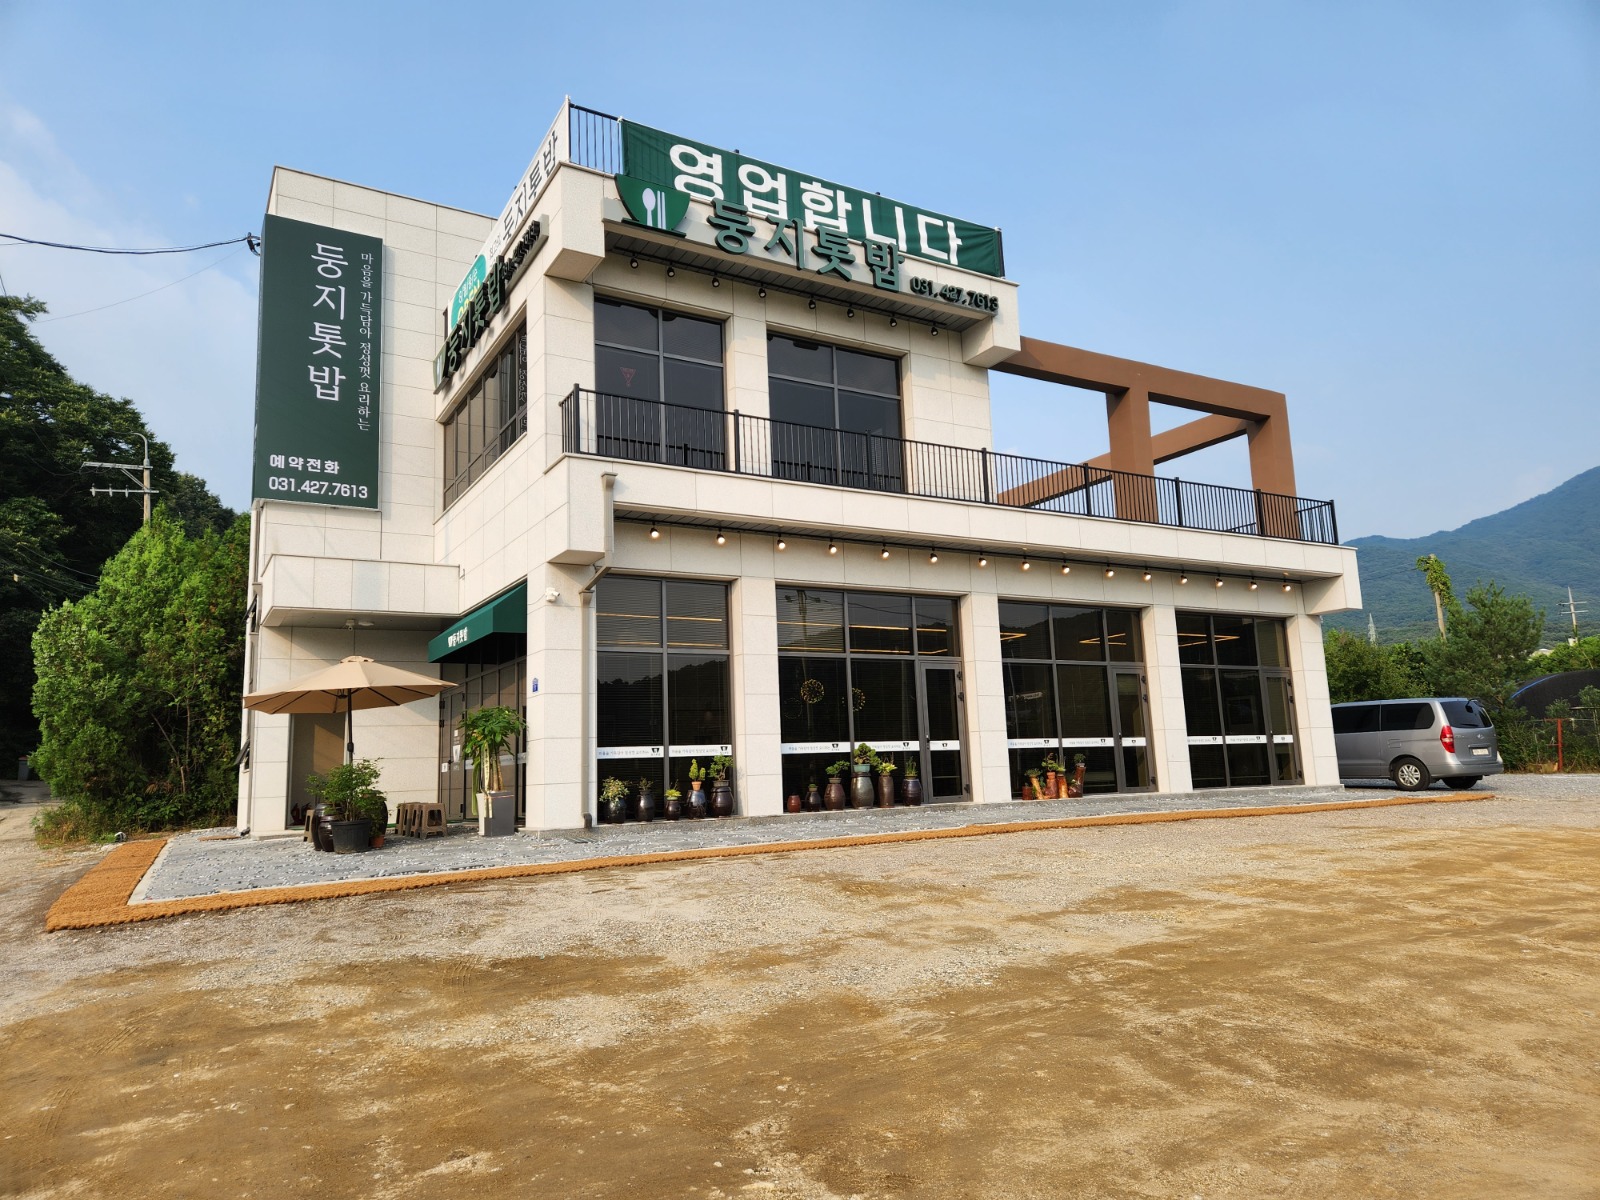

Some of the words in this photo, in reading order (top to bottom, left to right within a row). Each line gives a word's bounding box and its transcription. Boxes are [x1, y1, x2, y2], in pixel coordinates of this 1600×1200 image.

[670, 144, 963, 266] 영업합니다
[706, 198, 906, 292] 둥지톳밥
[360, 252, 374, 288] 마음을
[909, 276, 999, 312] 031.427.7613
[307, 242, 349, 402] 둥지톳밥
[358, 342, 371, 379] 정성껏
[357, 382, 371, 431] 요리하는
[269, 454, 340, 475] 예약전화
[268, 476, 368, 499] 031.427.7613
